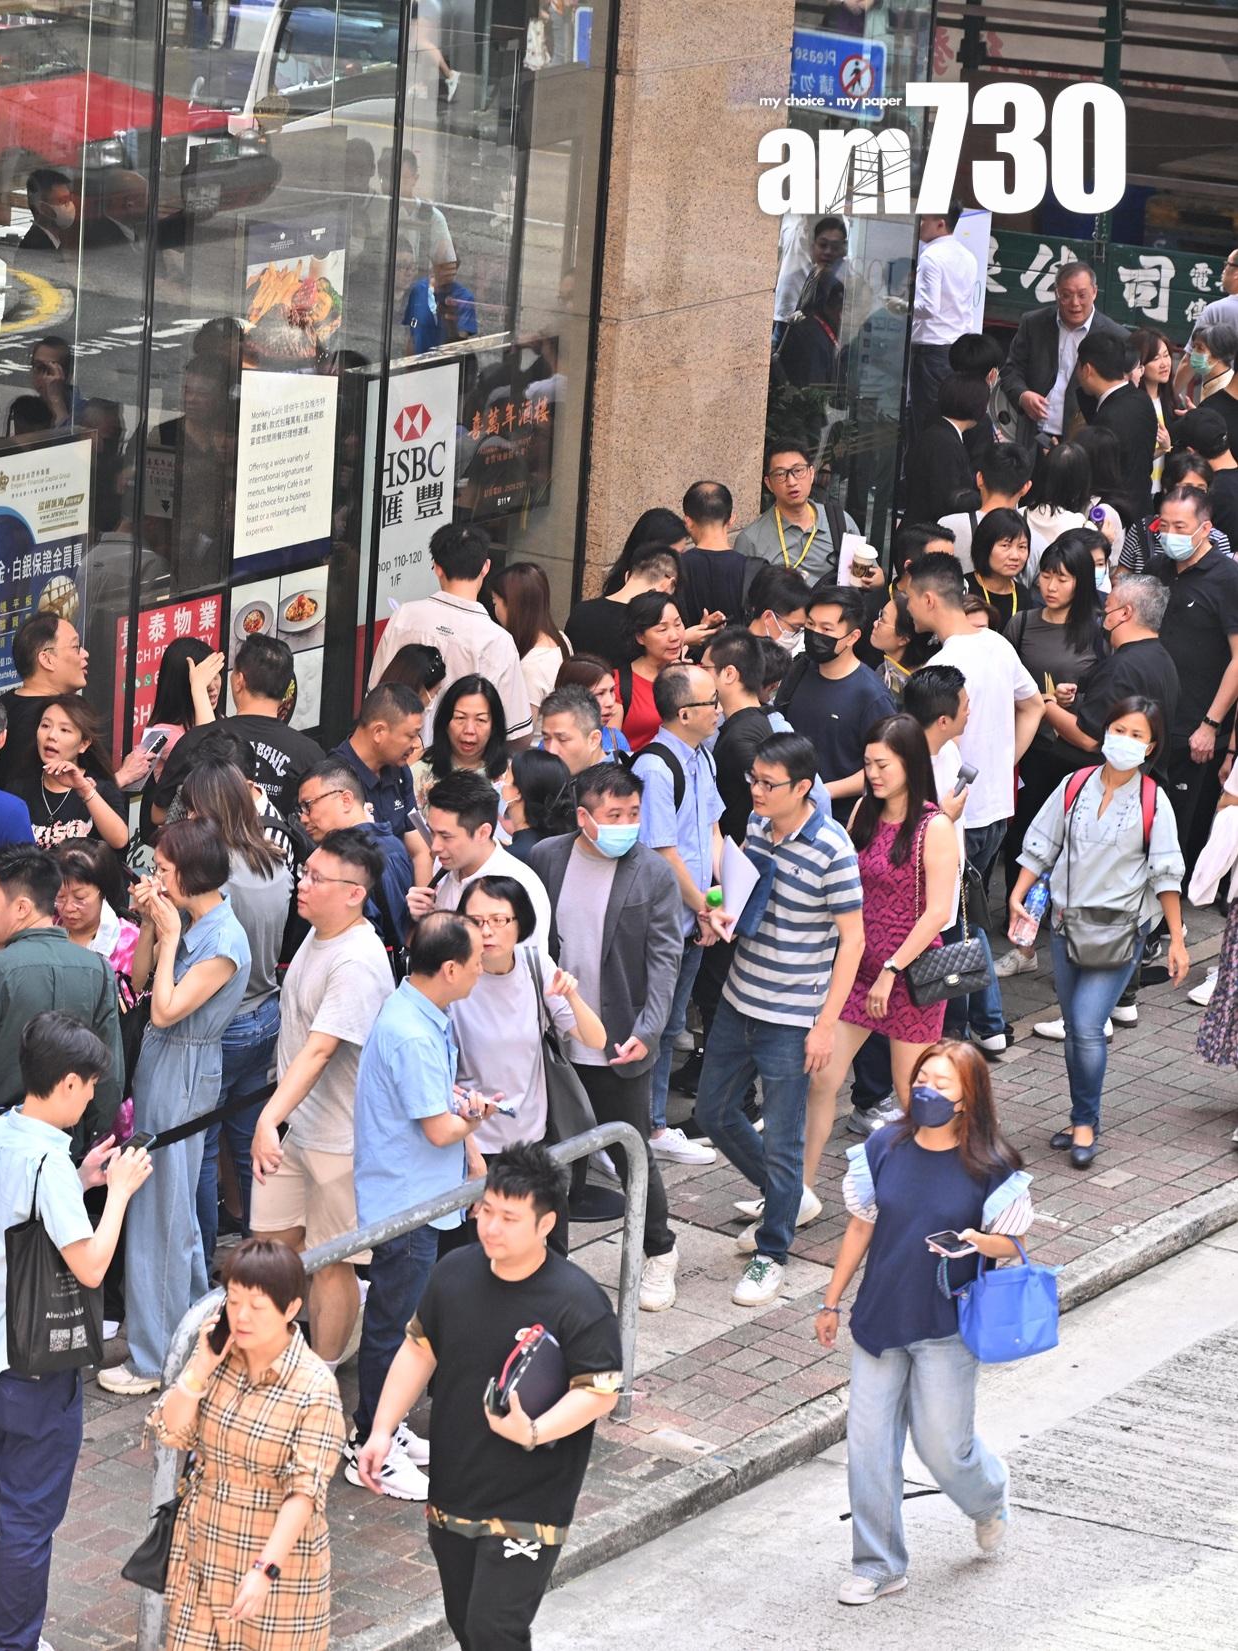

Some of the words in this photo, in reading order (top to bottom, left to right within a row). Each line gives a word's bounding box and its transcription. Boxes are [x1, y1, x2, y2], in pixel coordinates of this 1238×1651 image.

[248, 461, 269, 472] Offering
[274, 457, 287, 467] wide
[287, 454, 304, 465] variety
[304, 452, 311, 461] of
[248, 471, 281, 484] international
[281, 467, 305, 479] signature
[305, 464, 313, 472] set
[266, 483, 286, 494] Monkey
[247, 500, 260, 511] ideal
[260, 497, 276, 508] choice
[277, 495, 285, 504] for
[289, 490, 311, 502] business
[382, 481, 444, 529] 匯豐
[269, 507, 290, 519] relaxing
[290, 503, 307, 514] dining
[393, 550, 422, 569] 110-120
[390, 572, 402, 588] 1/F
